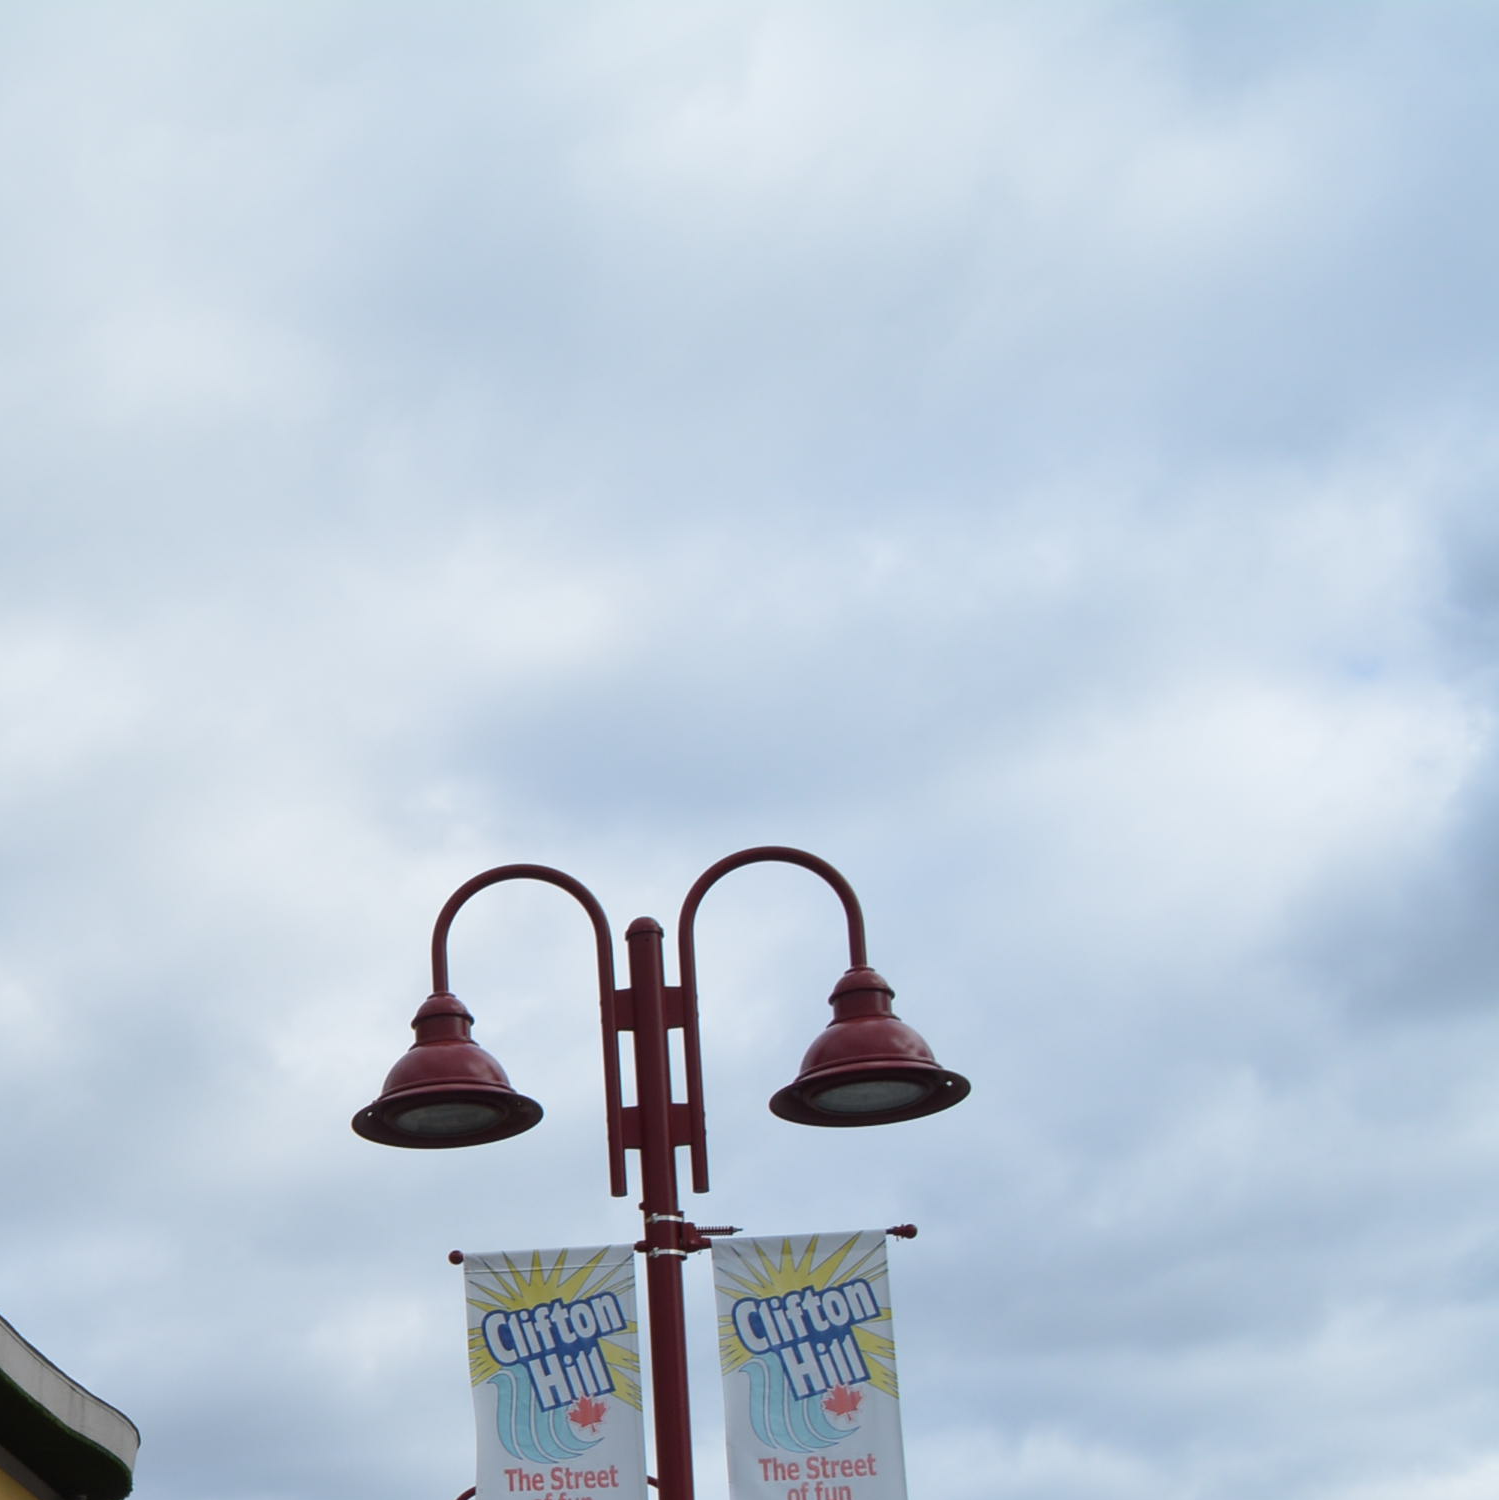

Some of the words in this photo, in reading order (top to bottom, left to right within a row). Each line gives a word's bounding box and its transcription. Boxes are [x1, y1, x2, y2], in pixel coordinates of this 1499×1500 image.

[483, 1292, 626, 1366] Clifton
[731, 1278, 881, 1355] Clifton
[528, 1345, 615, 1411] Hill
[780, 1334, 871, 1401] Hill
[505, 1468, 544, 1492] The
[551, 1465, 619, 1490] Street
[758, 1458, 800, 1481] The
[805, 1454, 877, 1479] Street
